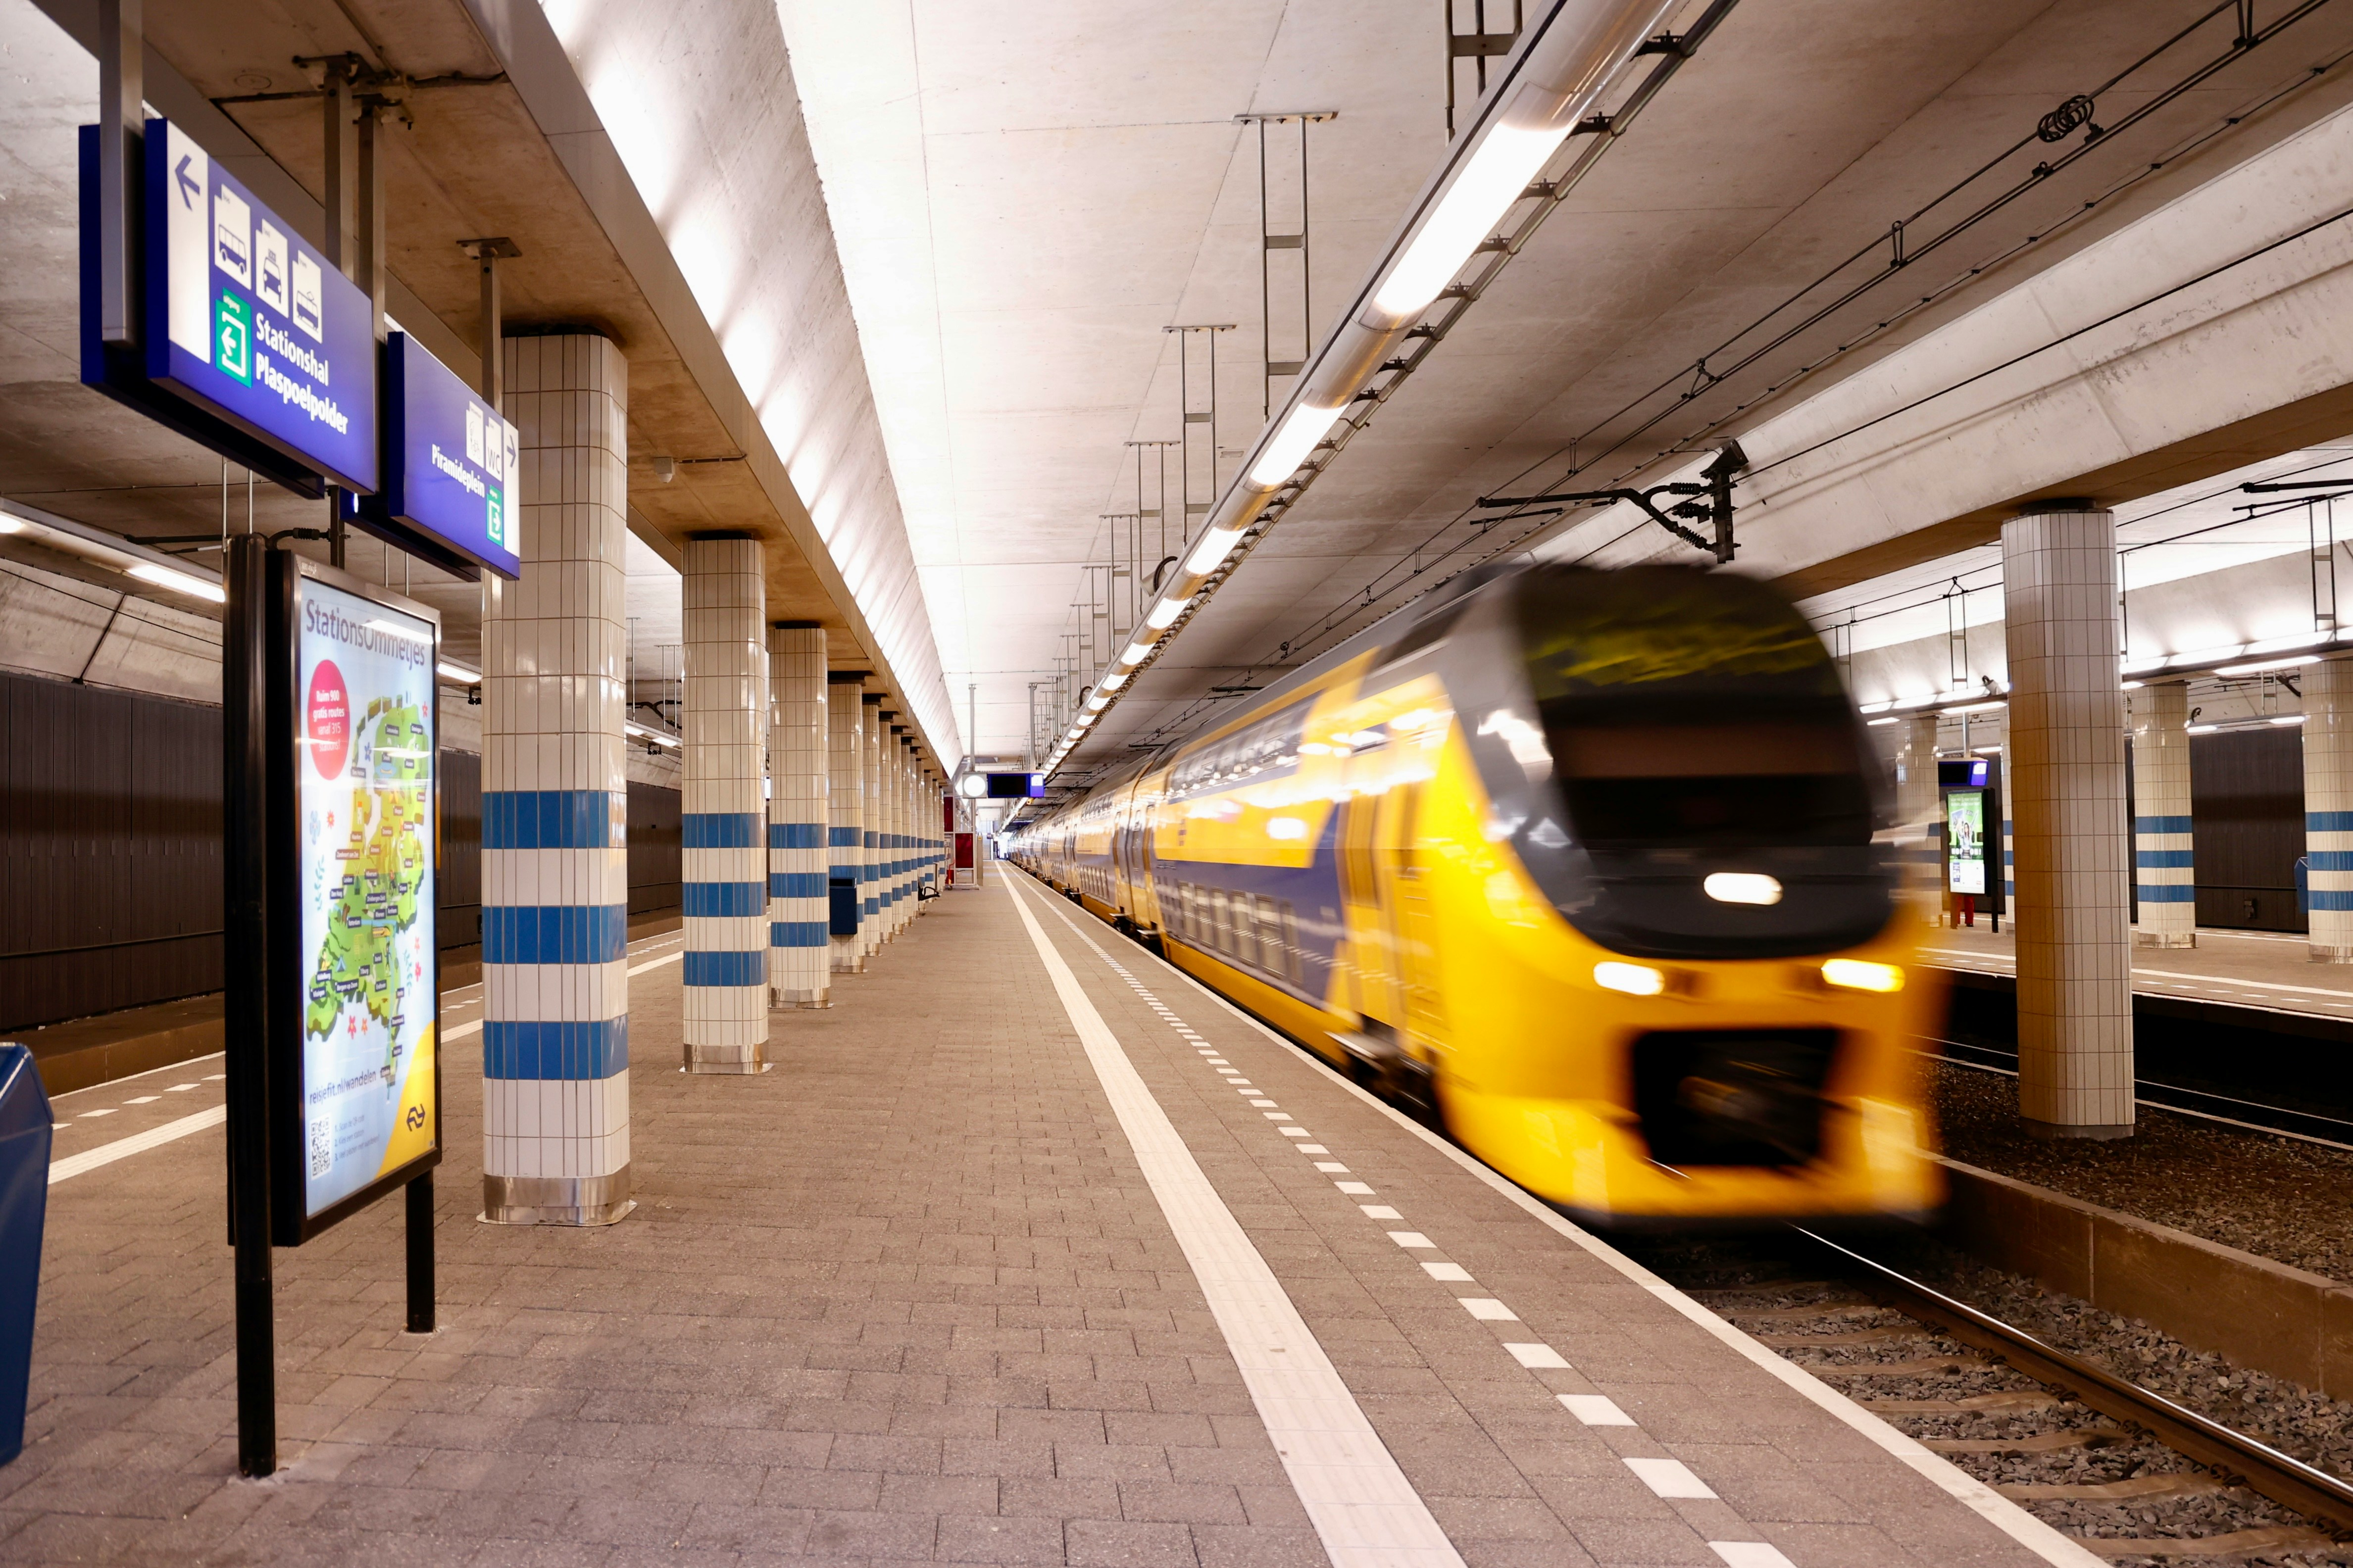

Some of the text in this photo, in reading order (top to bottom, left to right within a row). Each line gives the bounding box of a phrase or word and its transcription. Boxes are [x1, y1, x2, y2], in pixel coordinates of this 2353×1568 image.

[256, 312, 329, 387] Stationshal
[256, 351, 348, 435] Plaspoelpolder
[432, 443, 485, 498] Piramideplein
[487, 446, 500, 474] WC
[306, 599, 425, 670] StationsOmmetjes
[316, 689, 340, 702] Ruim 900
[313, 706, 345, 723] gratis routes
[317, 722, 341, 735] vanaf 315
[319, 739, 340, 752] stations!
[337, 983, 347, 992] Bergen
[309, 1069, 376, 1105] reisjefit.nl/wandelen
